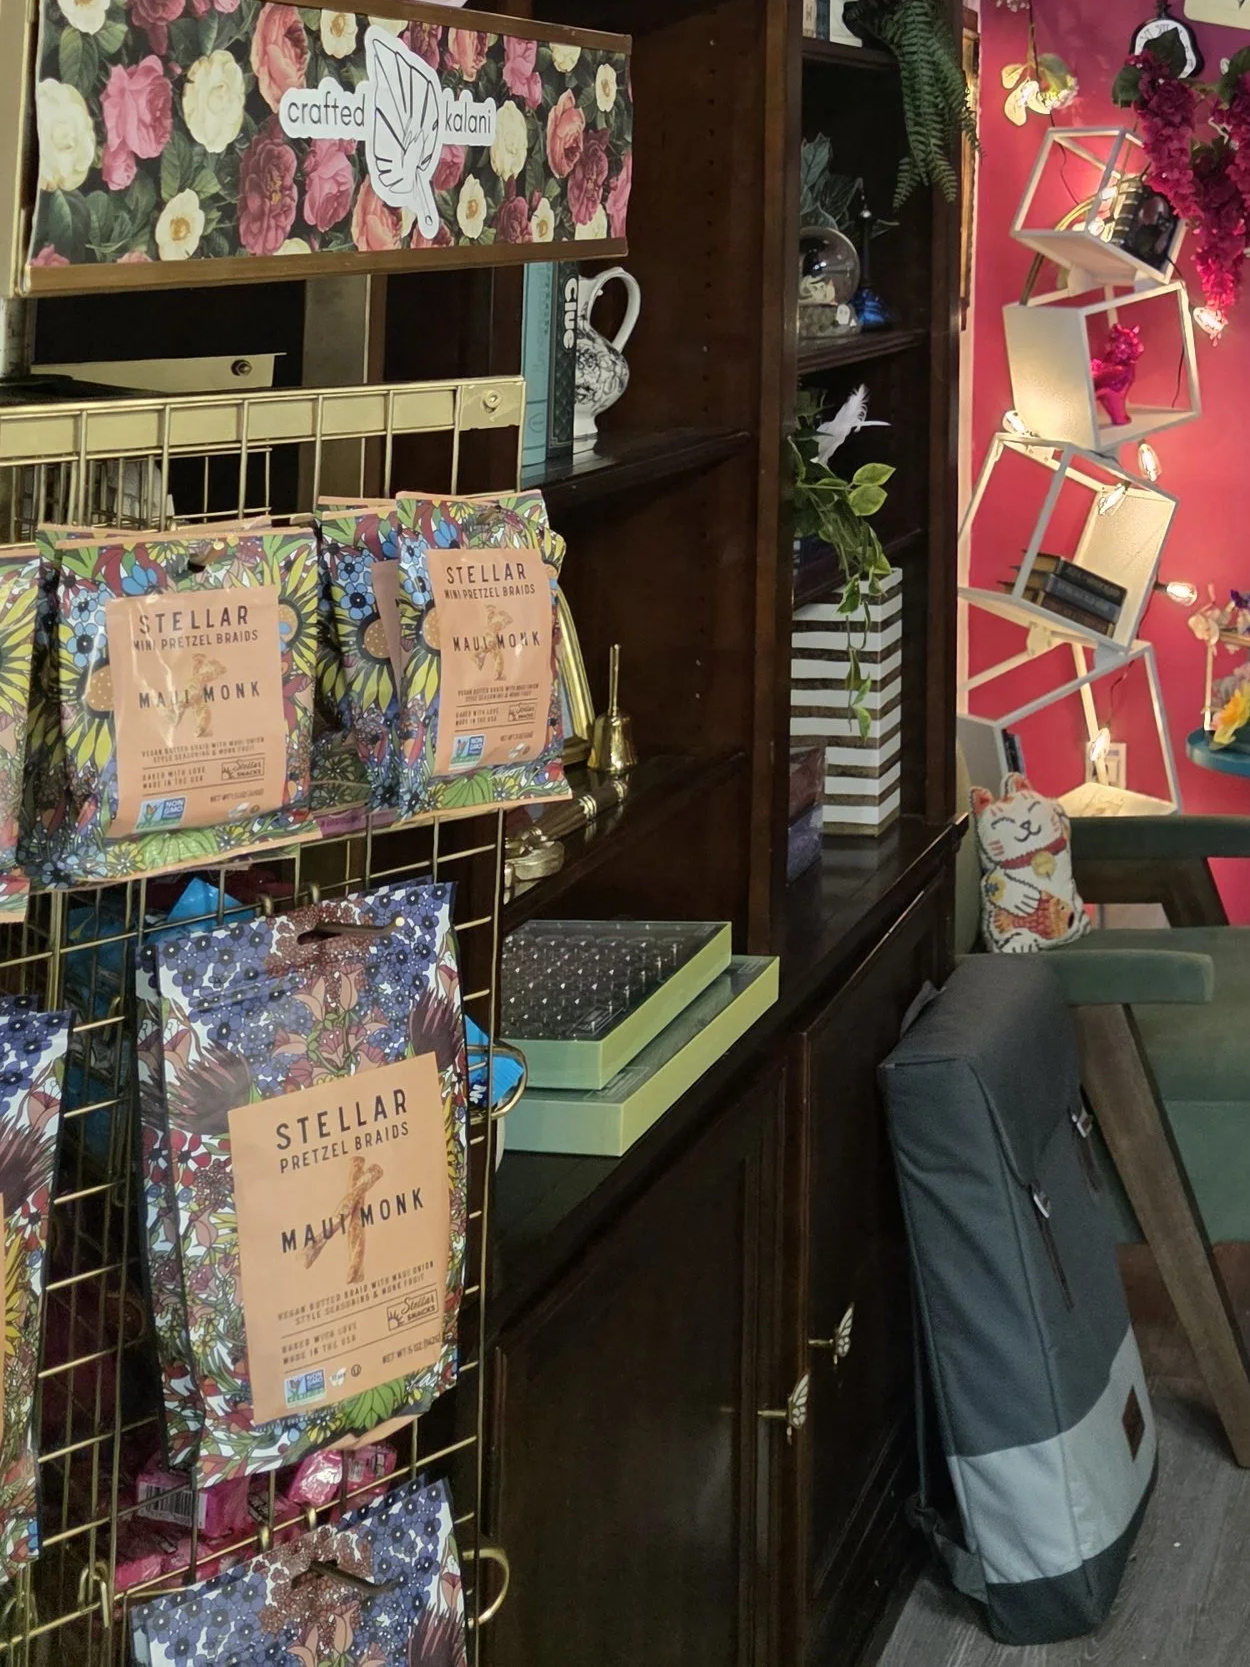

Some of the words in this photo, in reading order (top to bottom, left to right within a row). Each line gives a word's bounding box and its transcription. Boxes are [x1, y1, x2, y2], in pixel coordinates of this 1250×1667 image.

[287, 91, 365, 127] crafted
[445, 101, 491, 133] kalani
[446, 563, 527, 585] STELLAR
[444, 589, 461, 600] MINI
[463, 587, 503, 600] PRETZEL
[503, 583, 536, 596] BRAIDS
[139, 605, 248, 634] STELLAR
[161, 634, 212, 650] PRETZEL
[217, 629, 258, 644] BRAIDS
[452, 636, 488, 652] MAUI
[496, 631, 541, 650] MONK
[203, 681, 261, 703] MONK
[276, 1088, 407, 1150] STELLAR
[280, 1140, 348, 1174] PRETZEL
[355, 1121, 409, 1150] BRAIDS
[281, 1213, 346, 1253] MAUI
[360, 1187, 424, 1228] MONK
